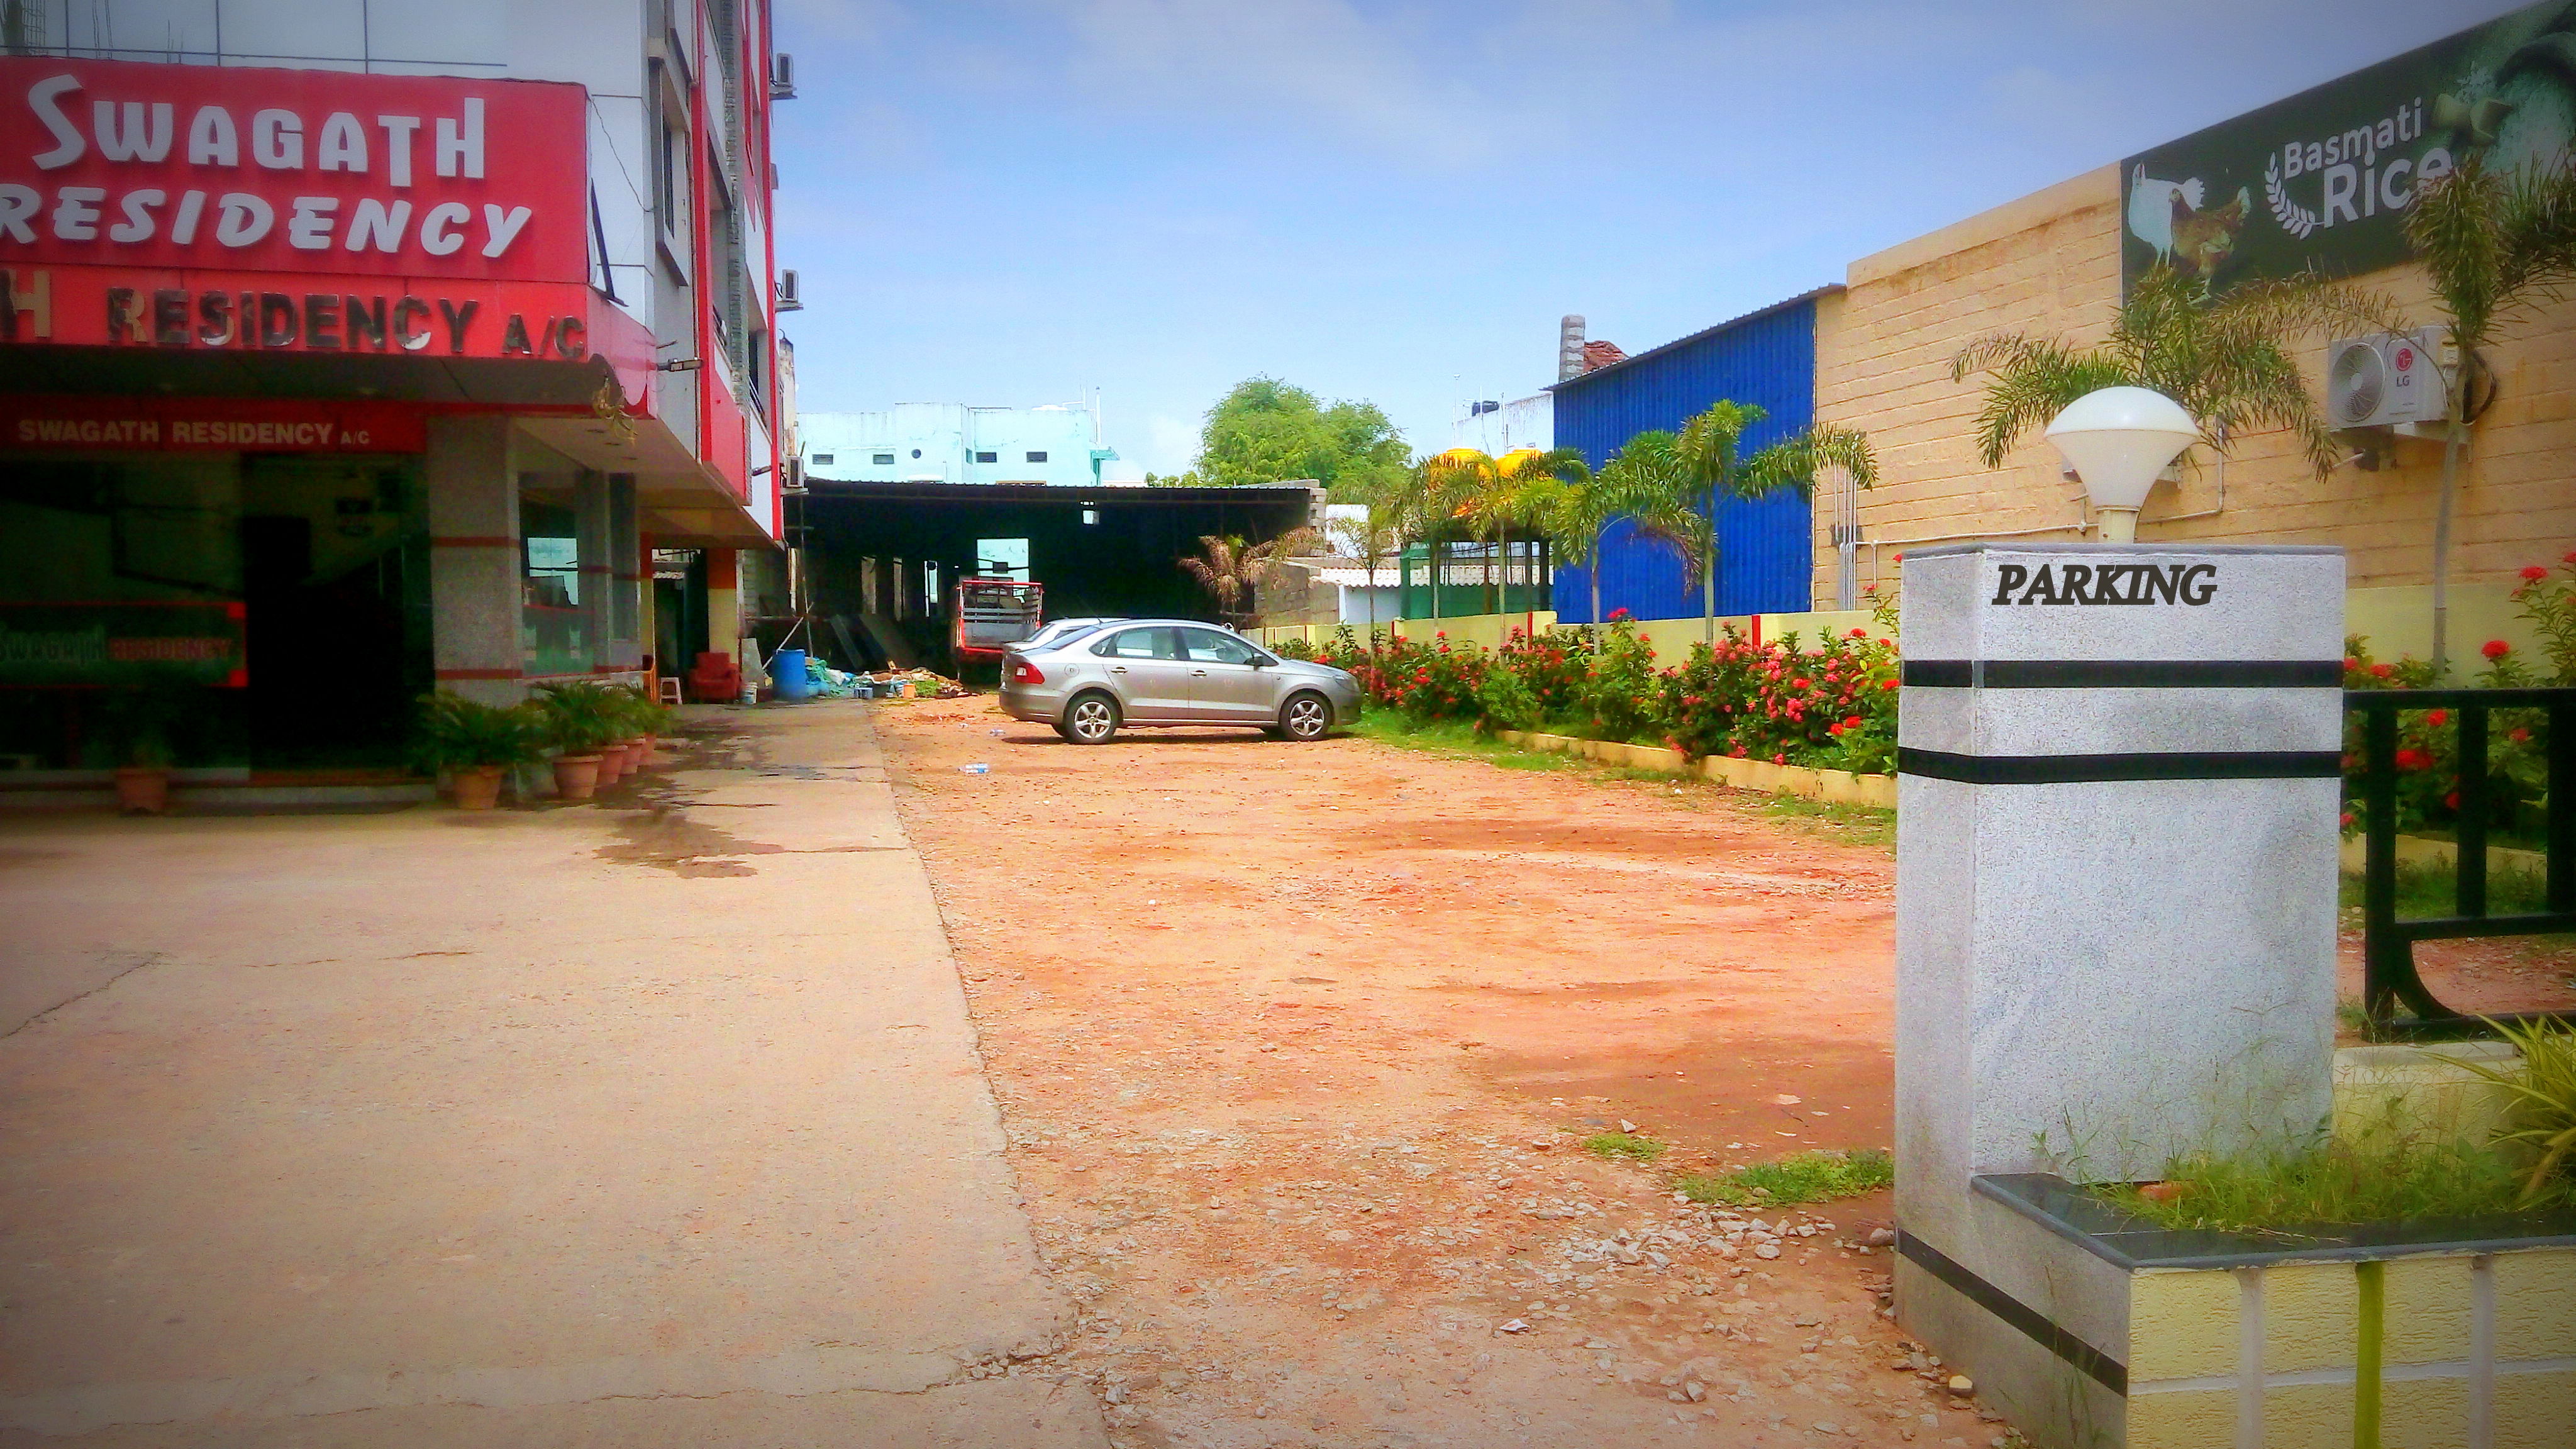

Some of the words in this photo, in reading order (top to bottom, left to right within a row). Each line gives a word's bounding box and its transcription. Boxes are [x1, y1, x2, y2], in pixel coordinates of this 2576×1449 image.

[27, 74, 486, 188] SWAGATH
[2284, 96, 2422, 180] Basmati
[0, 182, 532, 258] RESIDENCY
[2324, 147, 2453, 229] Rice
[108, 287, 479, 353] RESIDENCY
[503, 313, 585, 360] A/C
[2396, 375, 2410, 387] LG
[18, 419, 159, 442] SWAGATH
[172, 421, 333, 444] RESIDENCY
[340, 430, 370, 444] A/C
